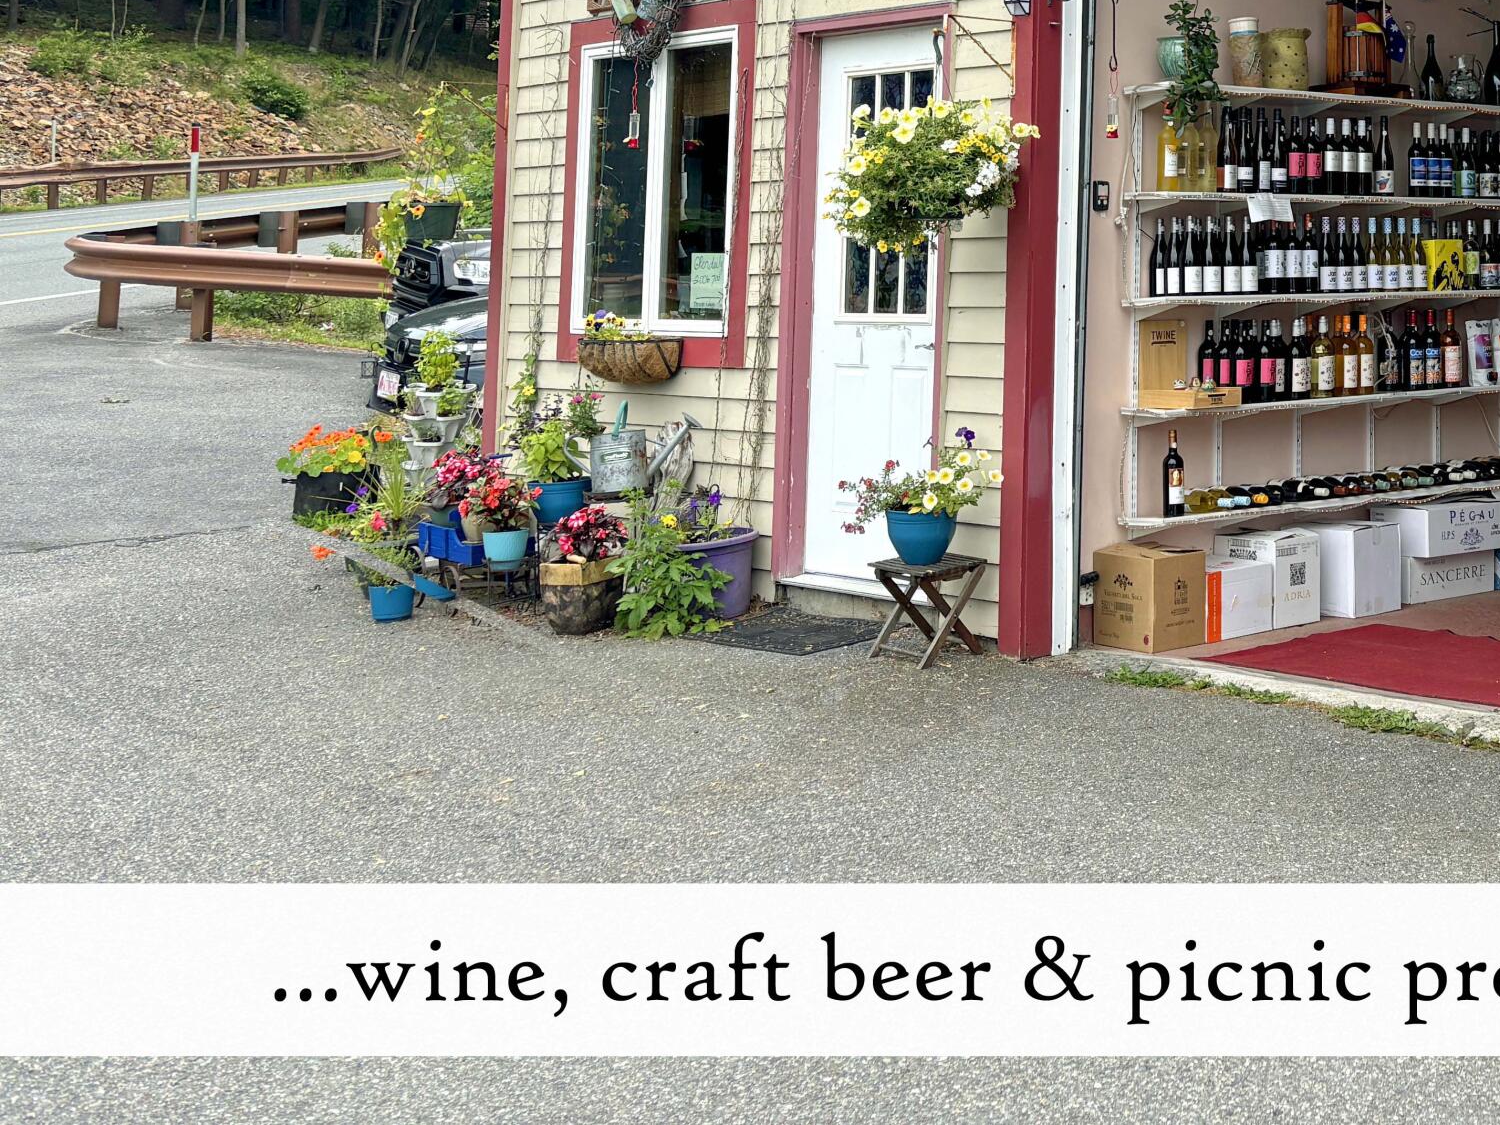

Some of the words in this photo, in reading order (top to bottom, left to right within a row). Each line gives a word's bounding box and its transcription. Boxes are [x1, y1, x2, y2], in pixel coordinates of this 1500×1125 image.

[1151, 330, 1176, 341] TWINE
[1449, 508, 1495, 524] PÉGAU
[1420, 564, 1486, 586] SANCERRE
